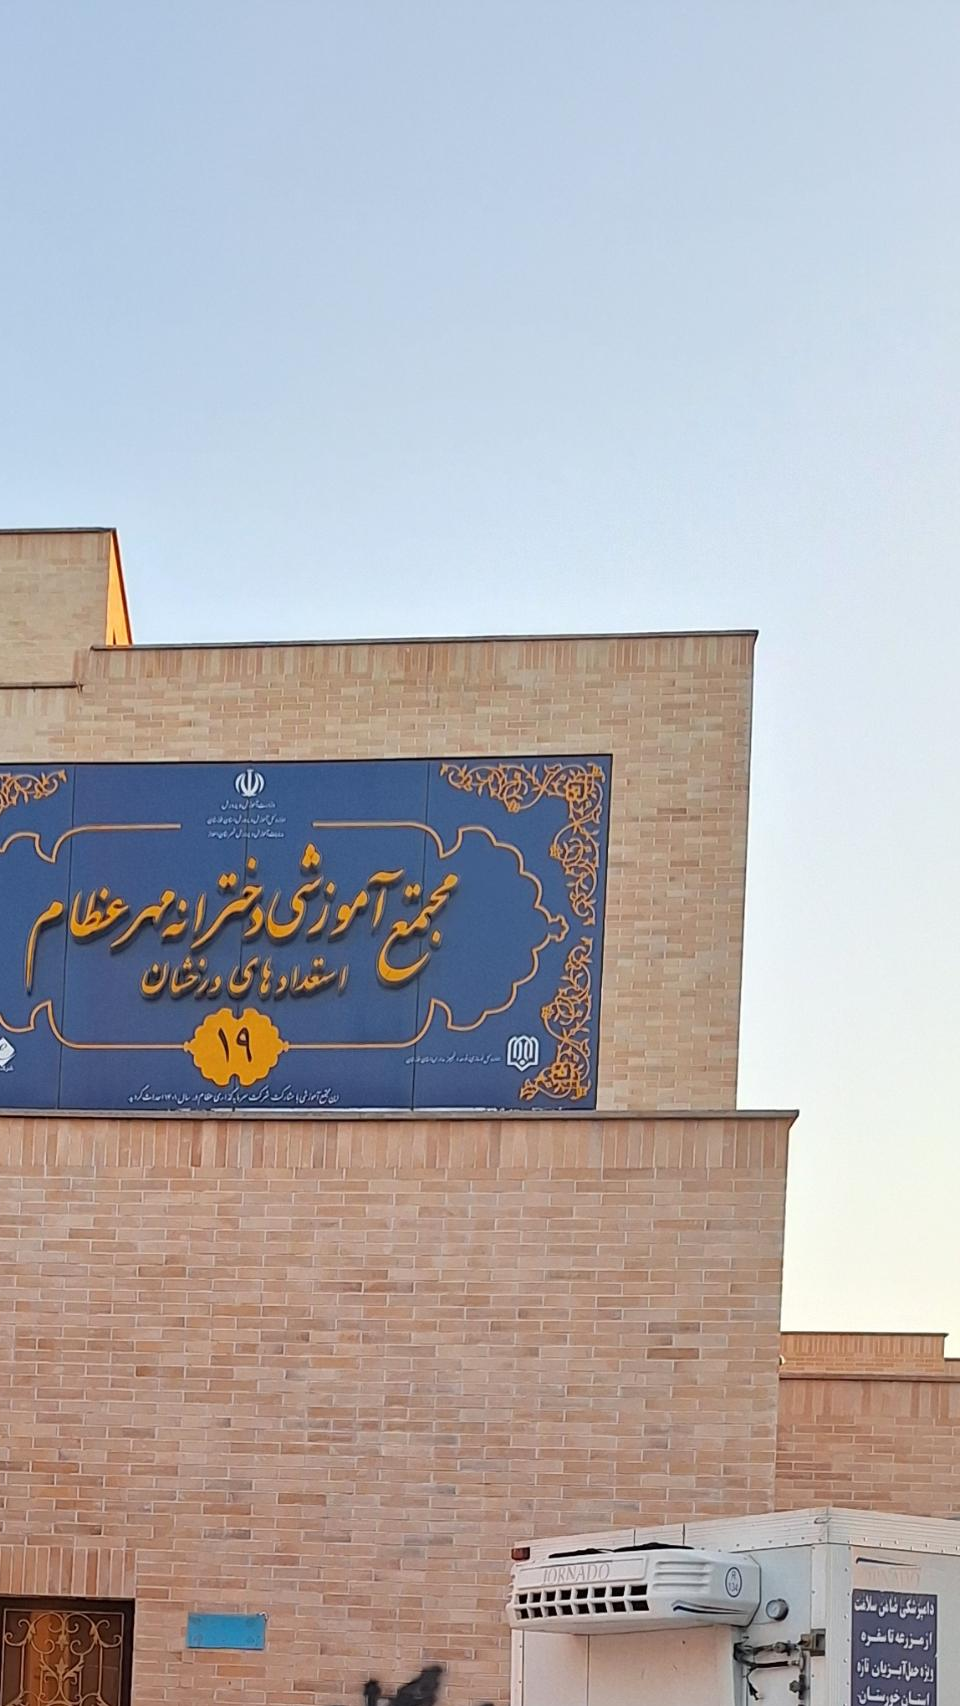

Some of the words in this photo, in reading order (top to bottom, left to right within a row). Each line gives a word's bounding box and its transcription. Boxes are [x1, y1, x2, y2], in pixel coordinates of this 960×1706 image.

[265, 842, 405, 940] آموزشی
[161, 856, 265, 950] دخترانه
[109, 888, 177, 949] مهر
[377, 873, 459, 983] مجتمع
[25, 886, 130, 993] عظام
[141, 957, 223, 996] درخشان
[217, 1026, 253, 1063] ۱۹
[248, 1084, 270, 1103] شرکت
[854, 1595, 878, 1612] سلامت
[900, 1598, 935, 1621] دامپزشکی
[861, 1628, 887, 1647] سفره
[887, 1628, 895, 1643] تا
[895, 1632, 924, 1649] مزرعه
[923, 1631, 933, 1651] از
[857, 1657, 870, 1678] تازه
[871, 1660, 907, 1680] آبزیان
[905, 1661, 919, 1682] حمل
[920, 1663, 934, 1683] ویژه
